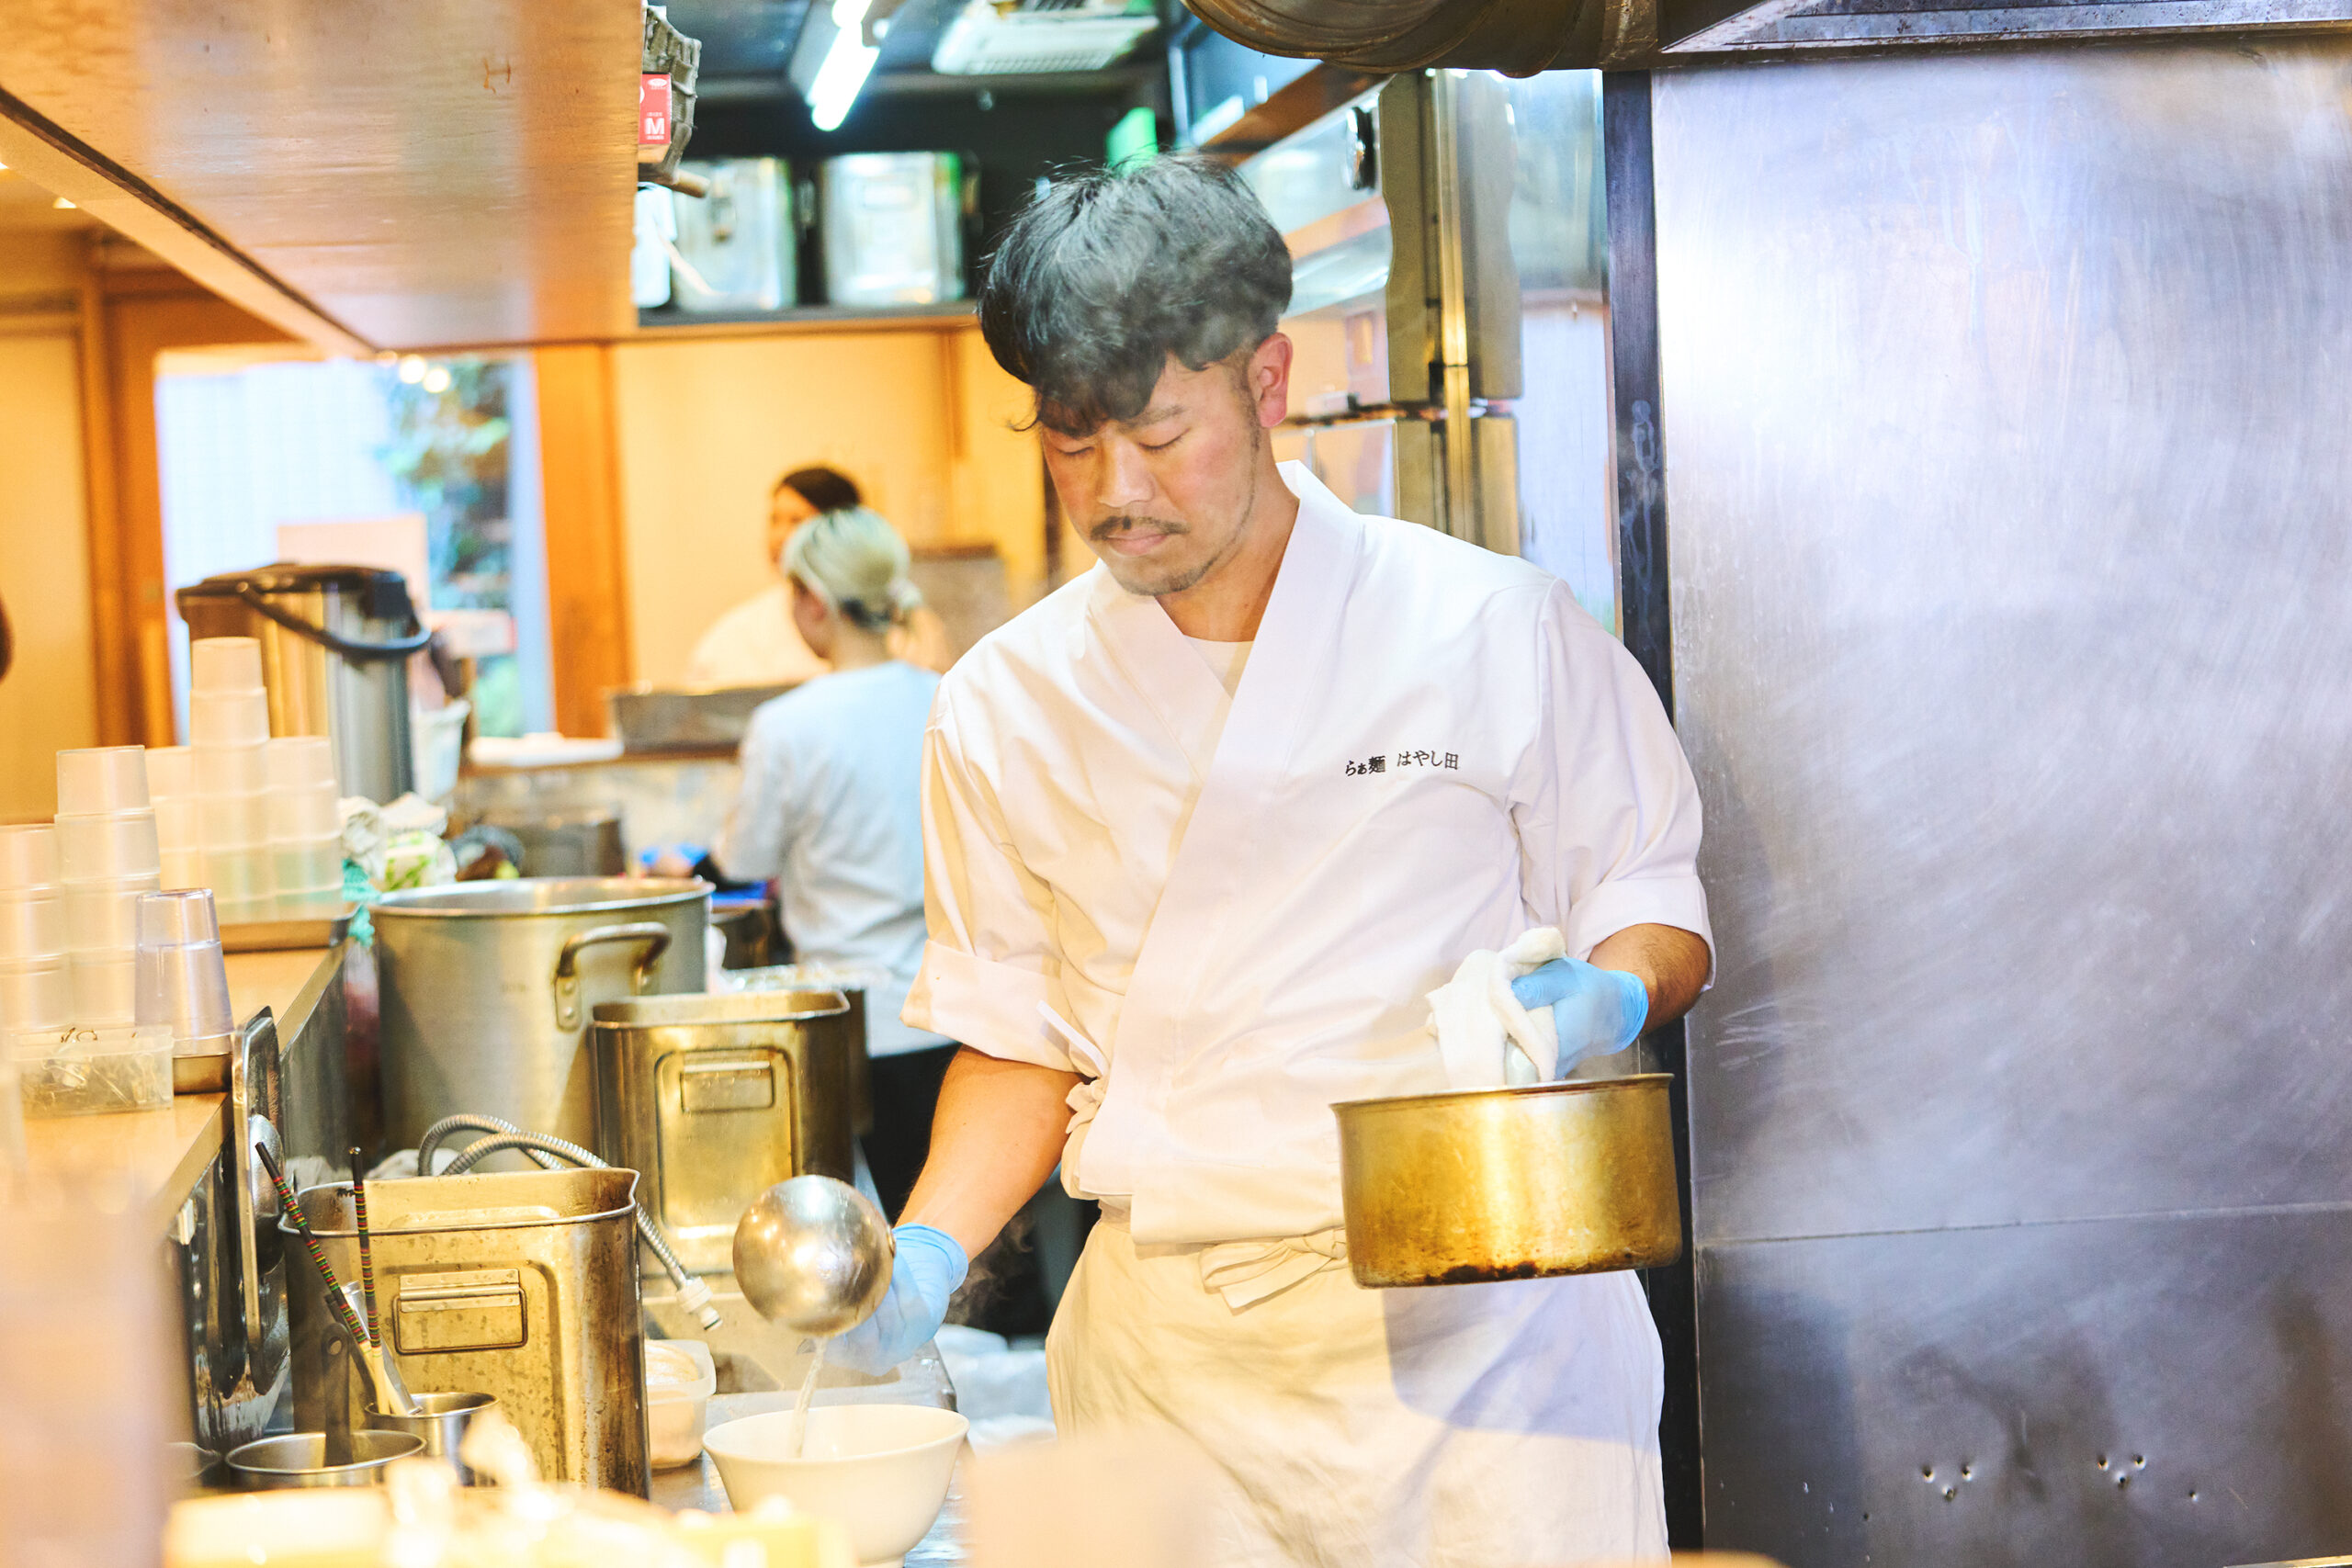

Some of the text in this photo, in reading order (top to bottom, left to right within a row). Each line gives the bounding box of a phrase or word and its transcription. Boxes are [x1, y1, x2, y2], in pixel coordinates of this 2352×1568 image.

[645, 118, 665, 135] M
[1396, 750, 1458, 770] はやし田
